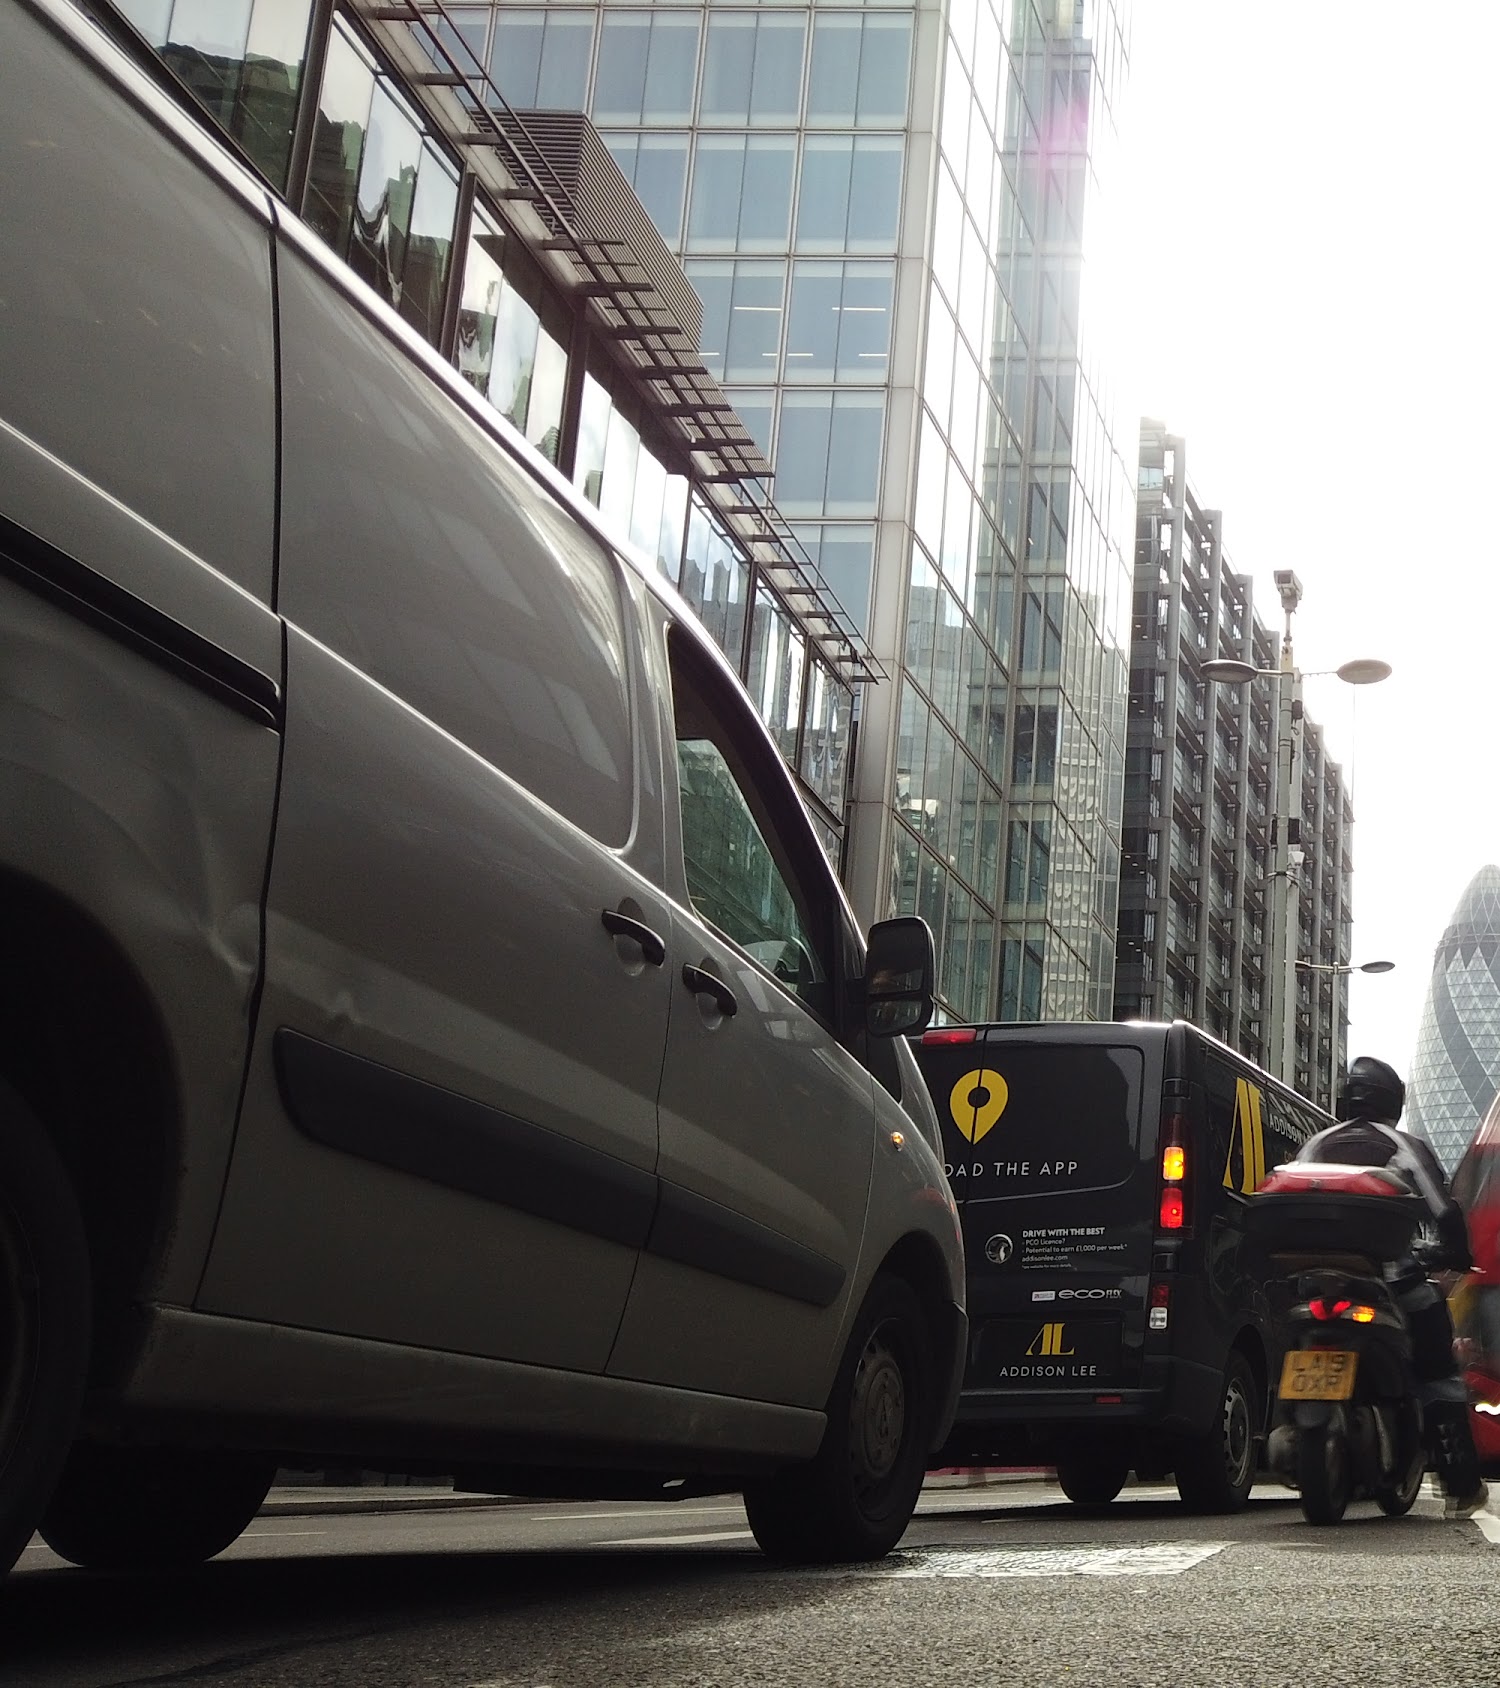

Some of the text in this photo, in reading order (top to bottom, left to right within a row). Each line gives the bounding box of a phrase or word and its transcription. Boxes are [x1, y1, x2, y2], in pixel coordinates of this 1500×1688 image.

[993, 1161, 1030, 1176] THE
[1039, 1161, 1078, 1176] APP
[1022, 1227, 1105, 1238] DRIVE WITH THE BEST
[1025, 1323, 1075, 1355] AL
[999, 1365, 1097, 1377] ADDISON LEE
